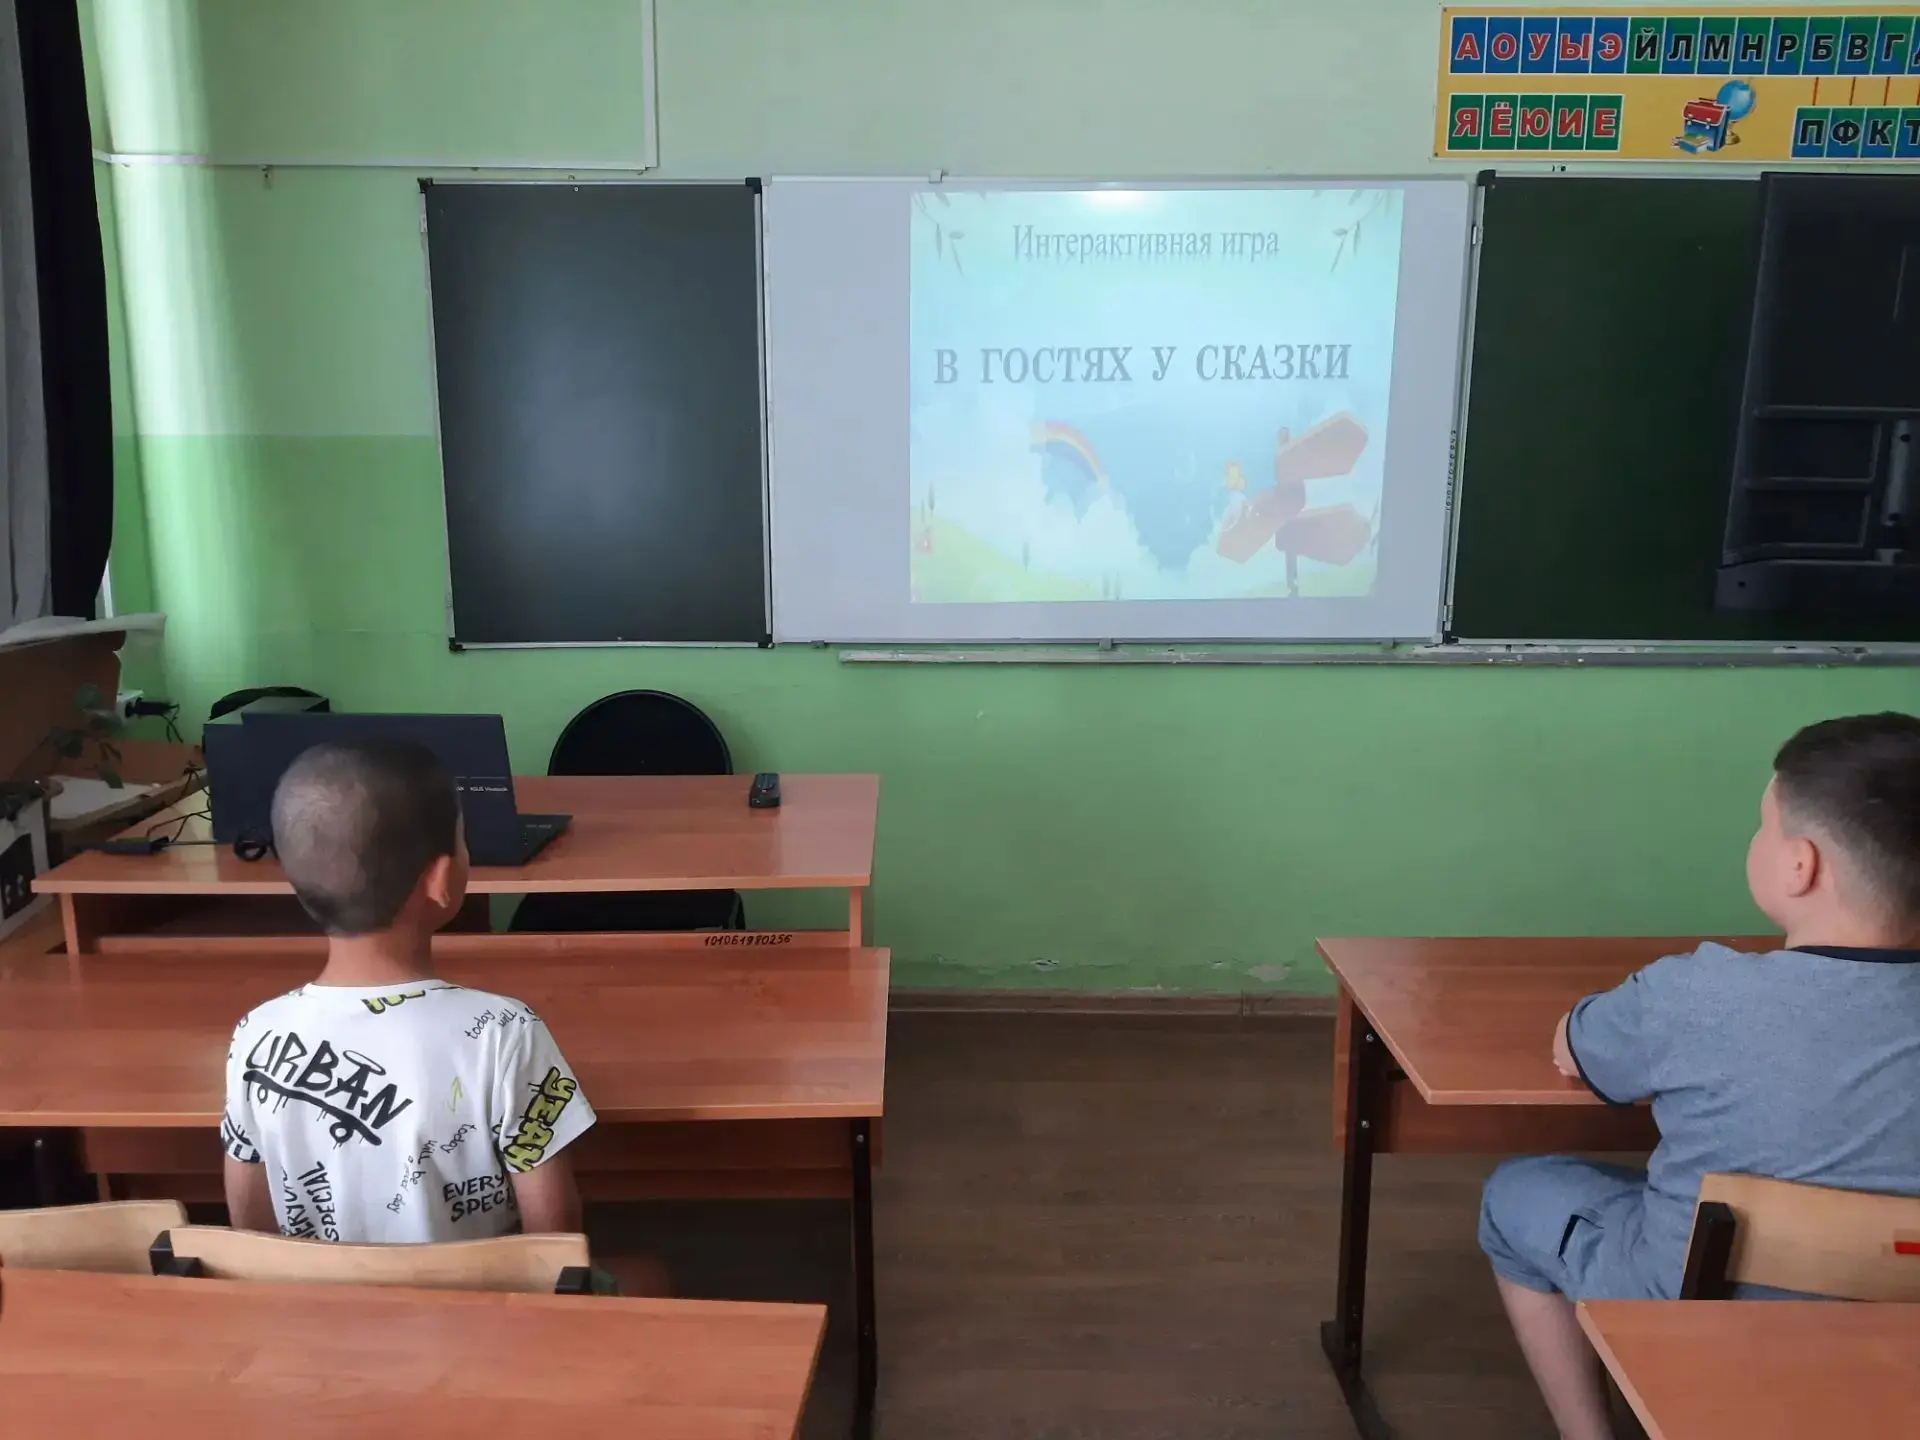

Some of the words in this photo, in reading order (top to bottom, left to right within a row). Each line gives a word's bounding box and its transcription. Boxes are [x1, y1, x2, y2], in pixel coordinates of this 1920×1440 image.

[1012, 224, 1212, 264] Интерактивная
[1220, 231, 1280, 263] игра
[933, 348, 958, 384] В
[979, 346, 1133, 384] ГОСТЯХ
[1151, 345, 1177, 382] У
[1195, 343, 1352, 382] СКАЗКИ
[464, 1009, 496, 1040] today
[245, 1029, 414, 1130] URBAN
[440, 1123, 477, 1154] today
[503, 1066, 577, 1173] YEAH
[296, 1161, 340, 1242] SPECIAL
